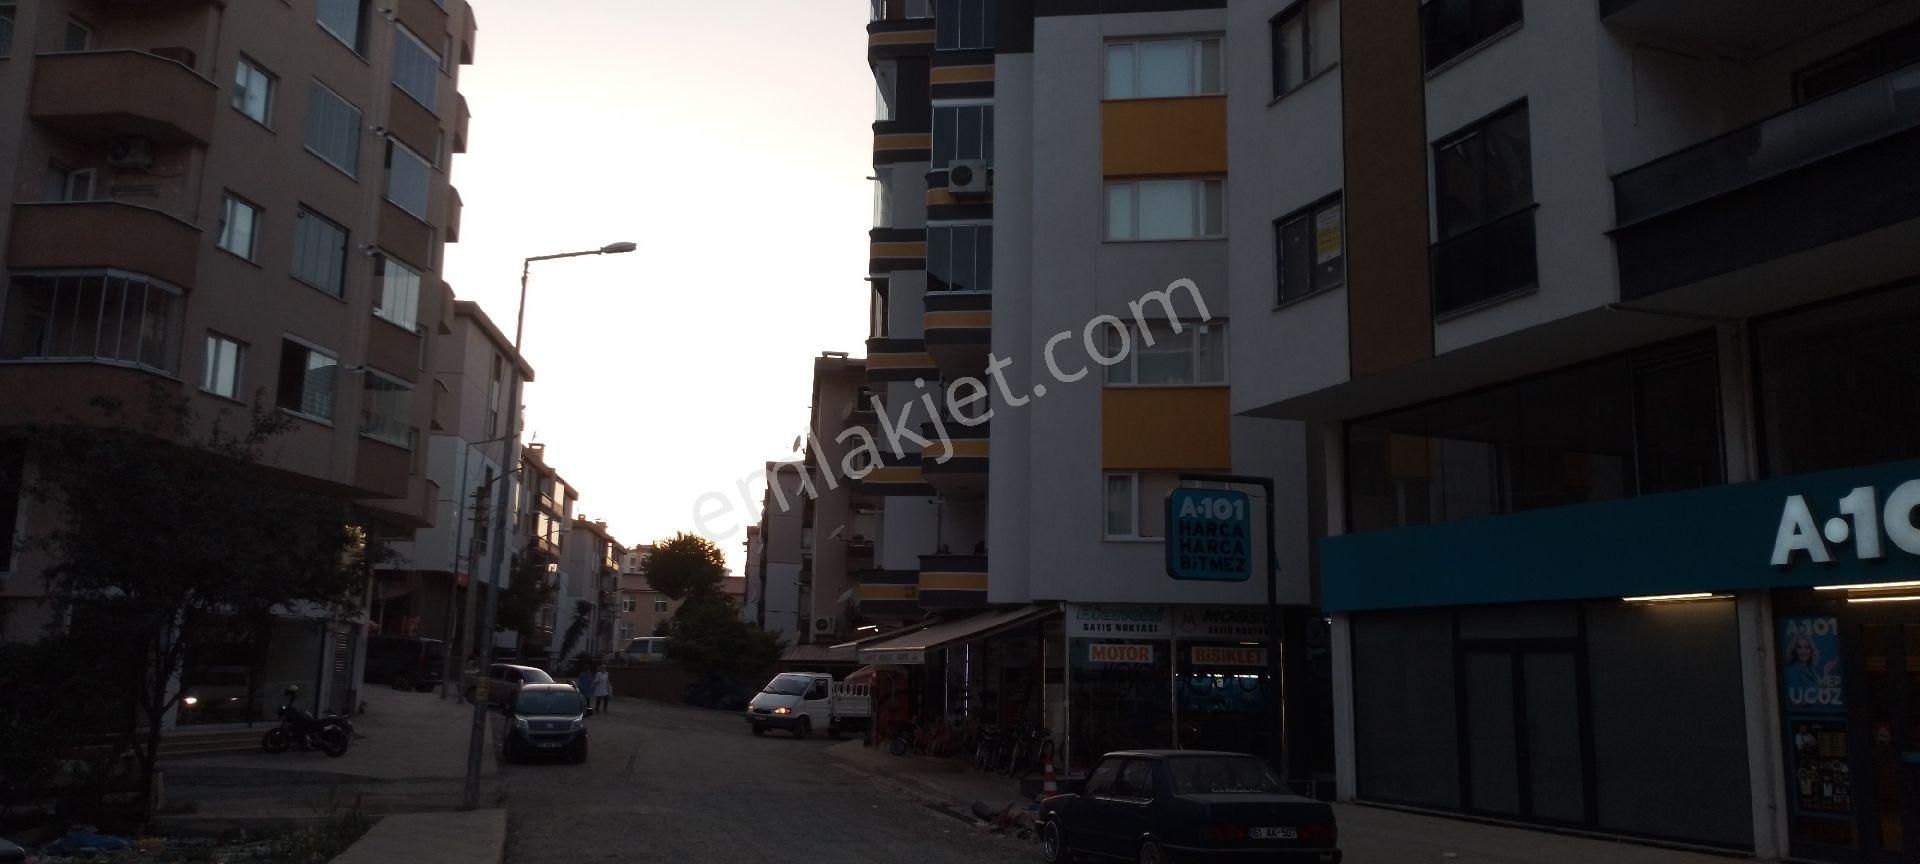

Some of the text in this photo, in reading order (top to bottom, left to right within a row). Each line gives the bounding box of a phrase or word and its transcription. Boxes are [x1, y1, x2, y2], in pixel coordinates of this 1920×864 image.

[1178, 519, 1245, 539] HARCA
[1179, 538, 1246, 556] HARCA
[1091, 645, 1150, 661] MOTOR
[1789, 687, 1843, 705] UCUZ
